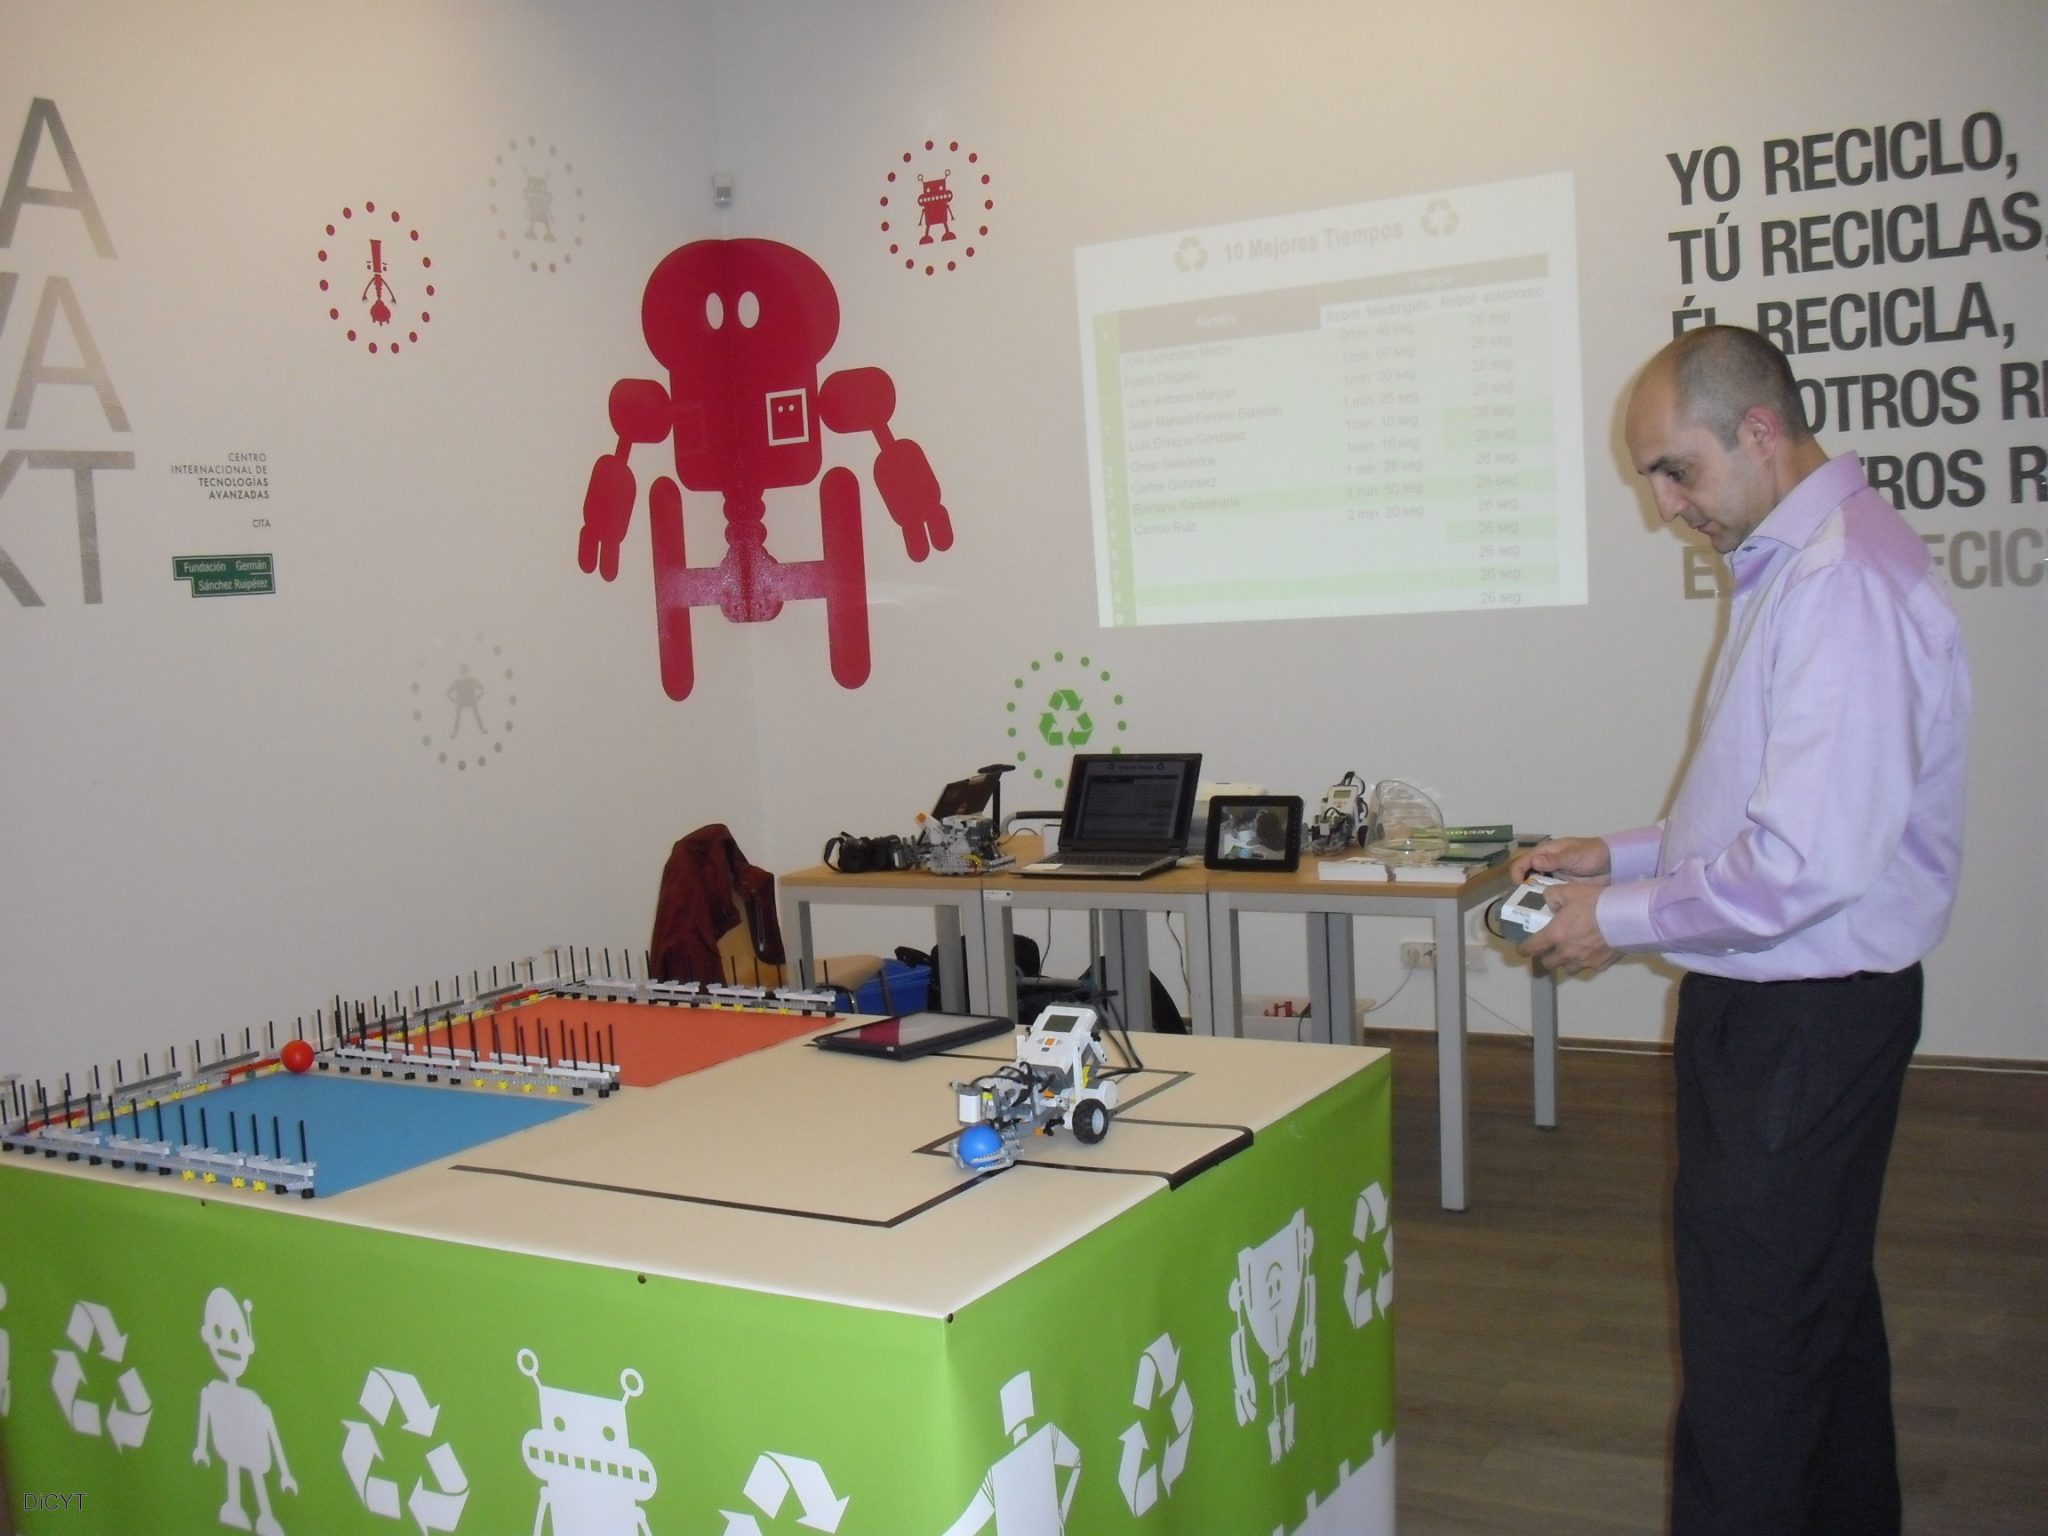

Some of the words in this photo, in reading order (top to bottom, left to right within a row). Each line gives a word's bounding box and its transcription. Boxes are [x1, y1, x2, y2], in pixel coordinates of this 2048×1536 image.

[1666, 145, 1741, 206] YO
[1763, 111, 2018, 196] RECICLO,
[1224, 241, 1243, 263] 10
[1249, 233, 1319, 263] Mejores
[1323, 221, 1404, 248] Tiempos
[1668, 212, 1741, 285] TÚ
[1440, 293, 1476, 309] Robot
[1196, 313, 1239, 328] Nombre
[1326, 308, 1360, 323] Robot
[1757, 281, 2015, 355] RECICLA,
[0, 272, 132, 432] A
[1153, 435, 1193, 451] Enrique
[228, 453, 267, 462] CENTRO
[171, 465, 252, 474] INTERNACIONAL
[256, 465, 267, 474] DE
[209, 490, 269, 499] AVANZADAS
[1132, 481, 1165, 494] Carlos
[1385, 505, 1400, 518] 20
[252, 518, 271, 528] CITA
[1134, 523, 1170, 536] Camilo
[1173, 520, 1196, 534] Ruiz
[184, 560, 226, 572] Fundación
[235, 560, 267, 571] Germán
[198, 579, 232, 591] Sánchez
[234, 577, 268, 590] Ruipérez
